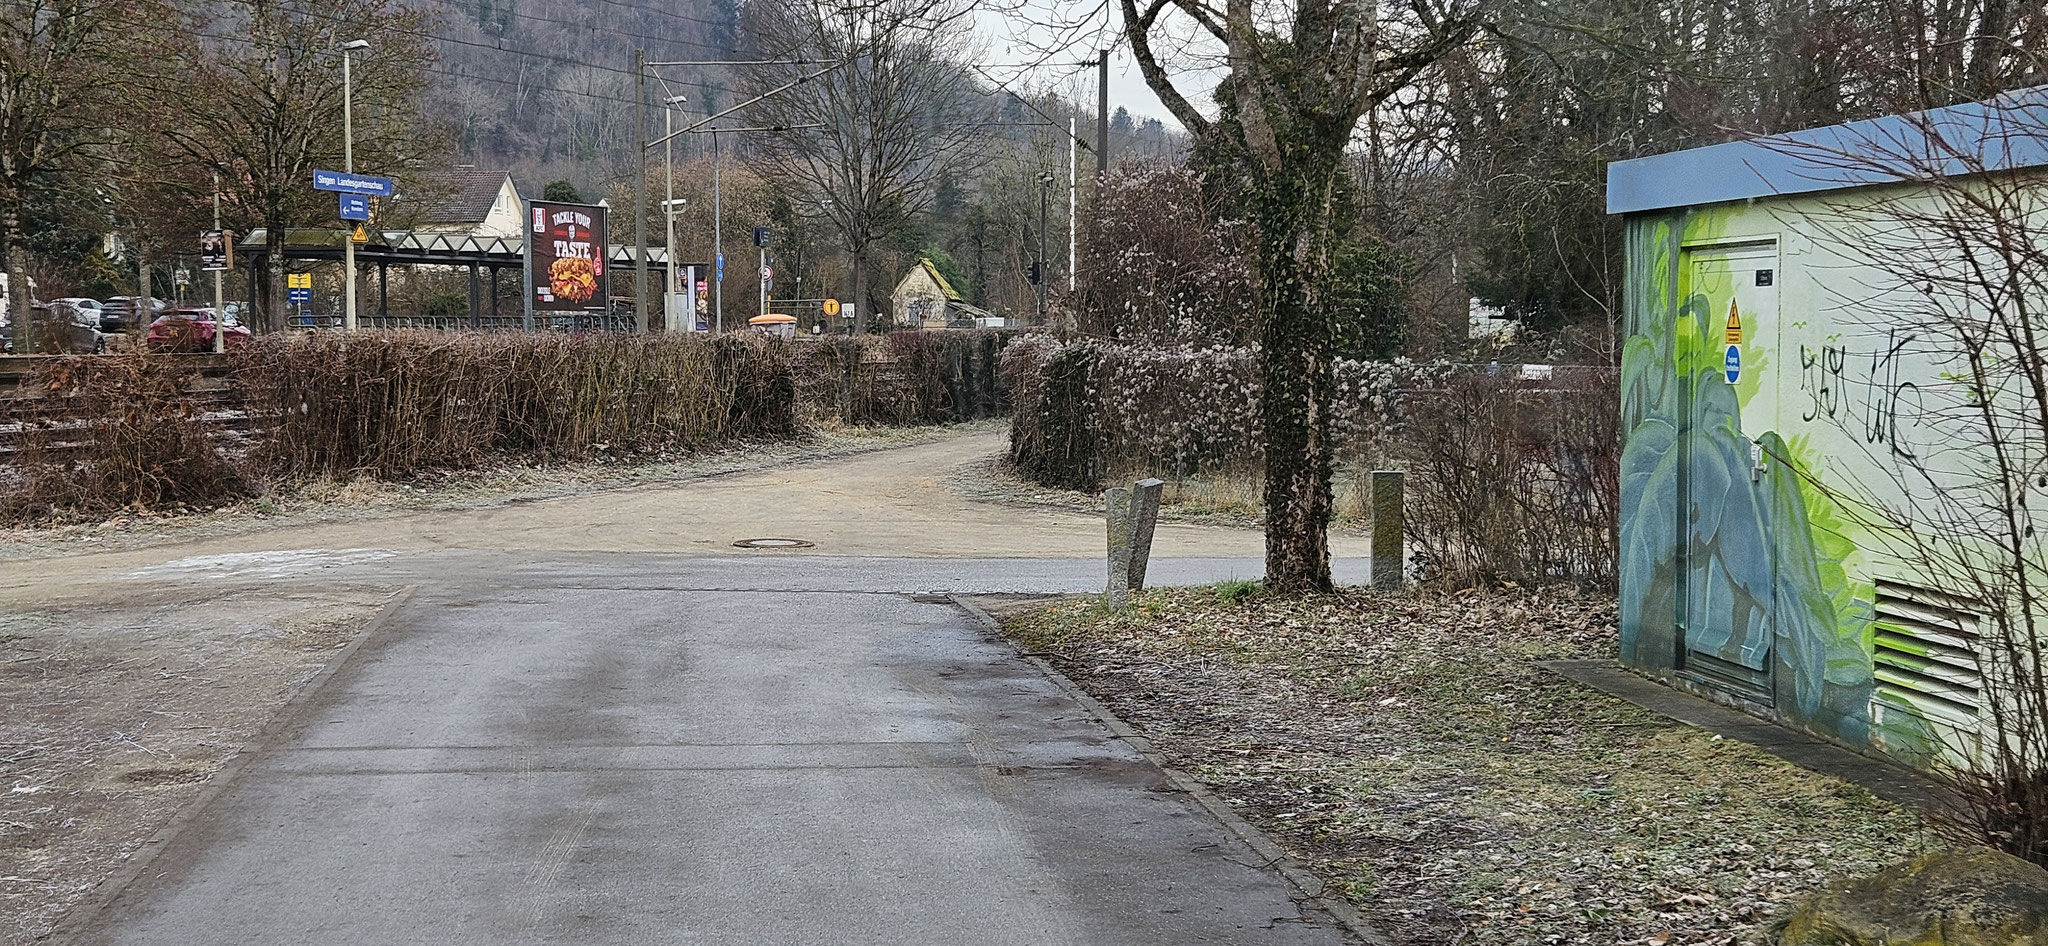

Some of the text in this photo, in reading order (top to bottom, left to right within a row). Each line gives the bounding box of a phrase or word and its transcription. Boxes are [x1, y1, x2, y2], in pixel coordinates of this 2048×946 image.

[318, 175, 384, 190] Singen Landesgartenschau
[552, 211, 591, 229] TACKLE YOUR
[553, 240, 591, 259] TASTE
